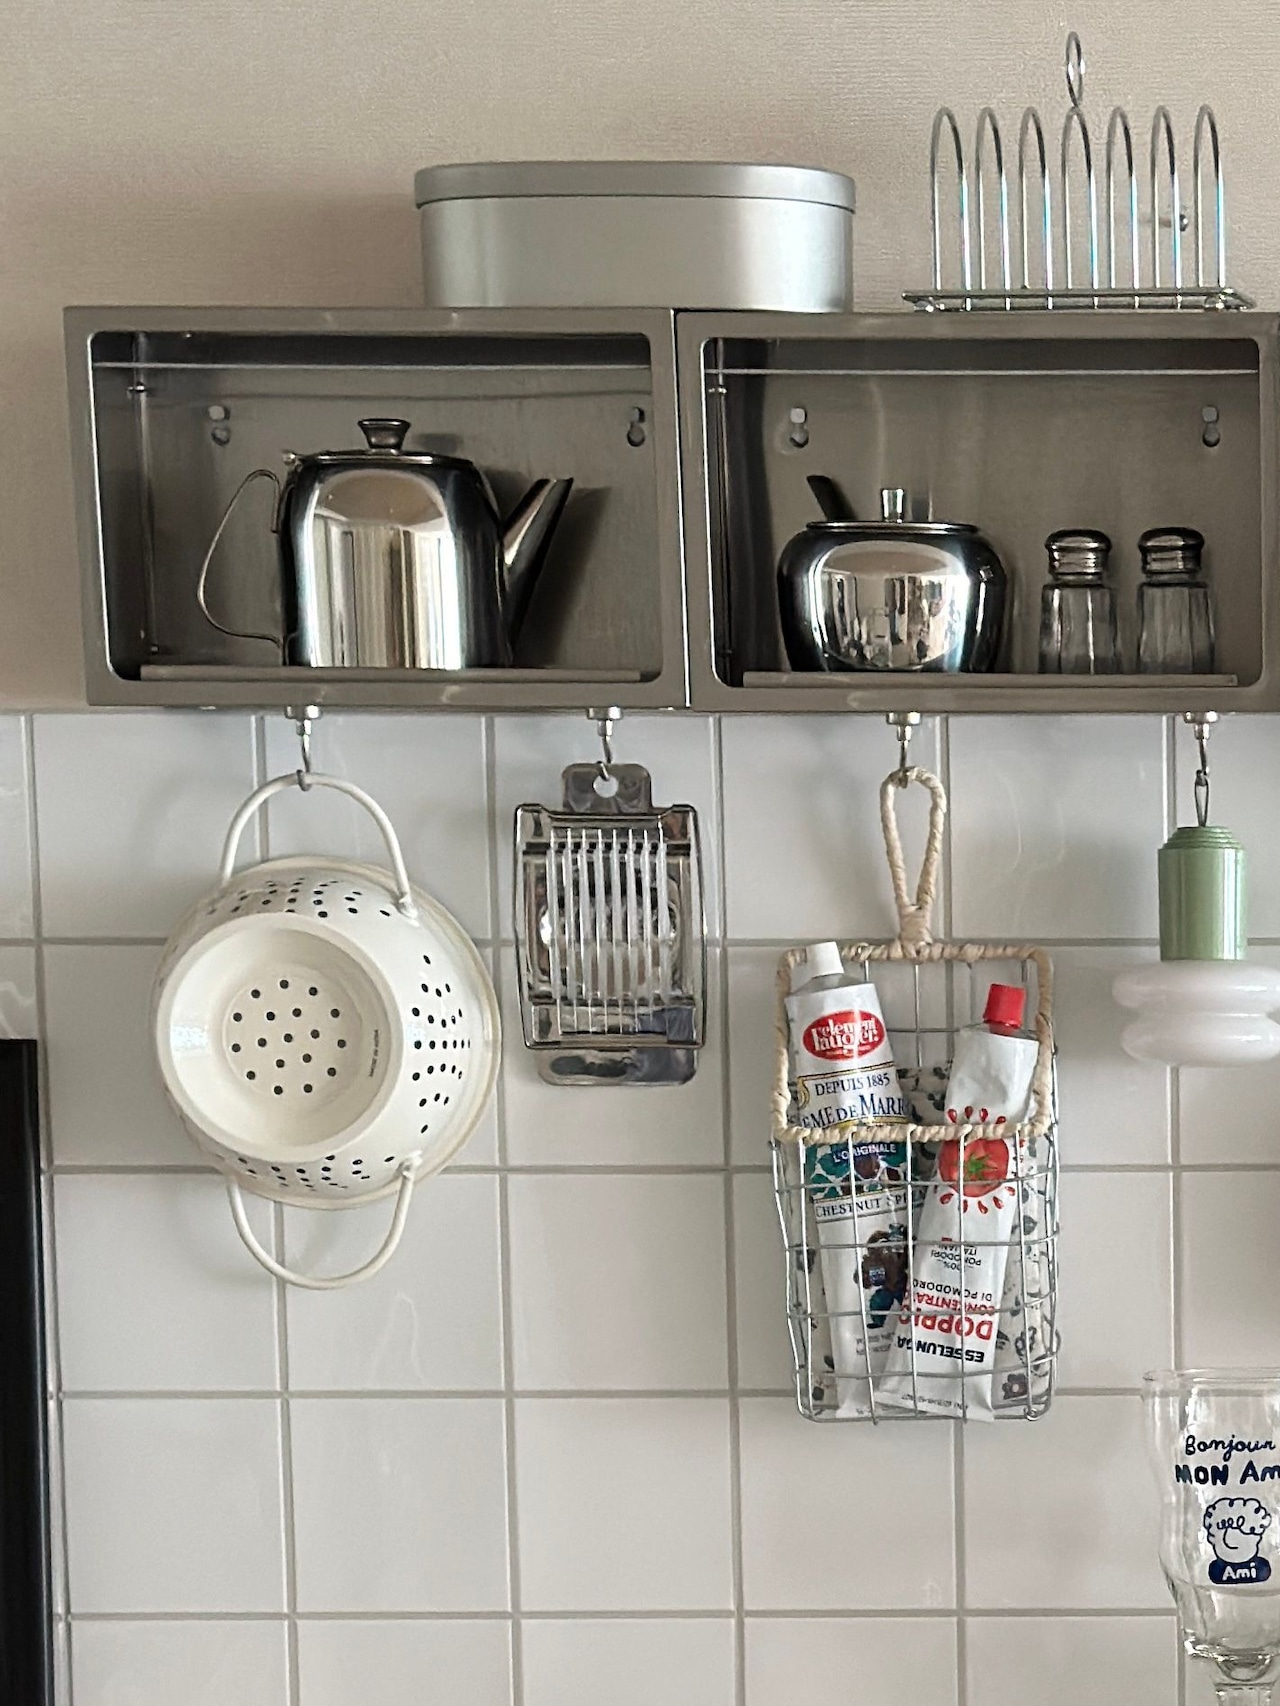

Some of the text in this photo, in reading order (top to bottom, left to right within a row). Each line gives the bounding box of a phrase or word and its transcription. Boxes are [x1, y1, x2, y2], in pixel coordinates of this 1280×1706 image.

[814, 1072, 890, 1097] DEPUIS 1885
[836, 1105, 858, 1120] DE
[816, 1199, 880, 1217] CHESTNUT
[981, 1293, 993, 1302] DI
[899, 1304, 993, 1341] DOPPIO
[1185, 1434, 1276, 1462] Bonjour
[1175, 1464, 1229, 1486] MON
[1222, 1562, 1257, 1581] Ami
